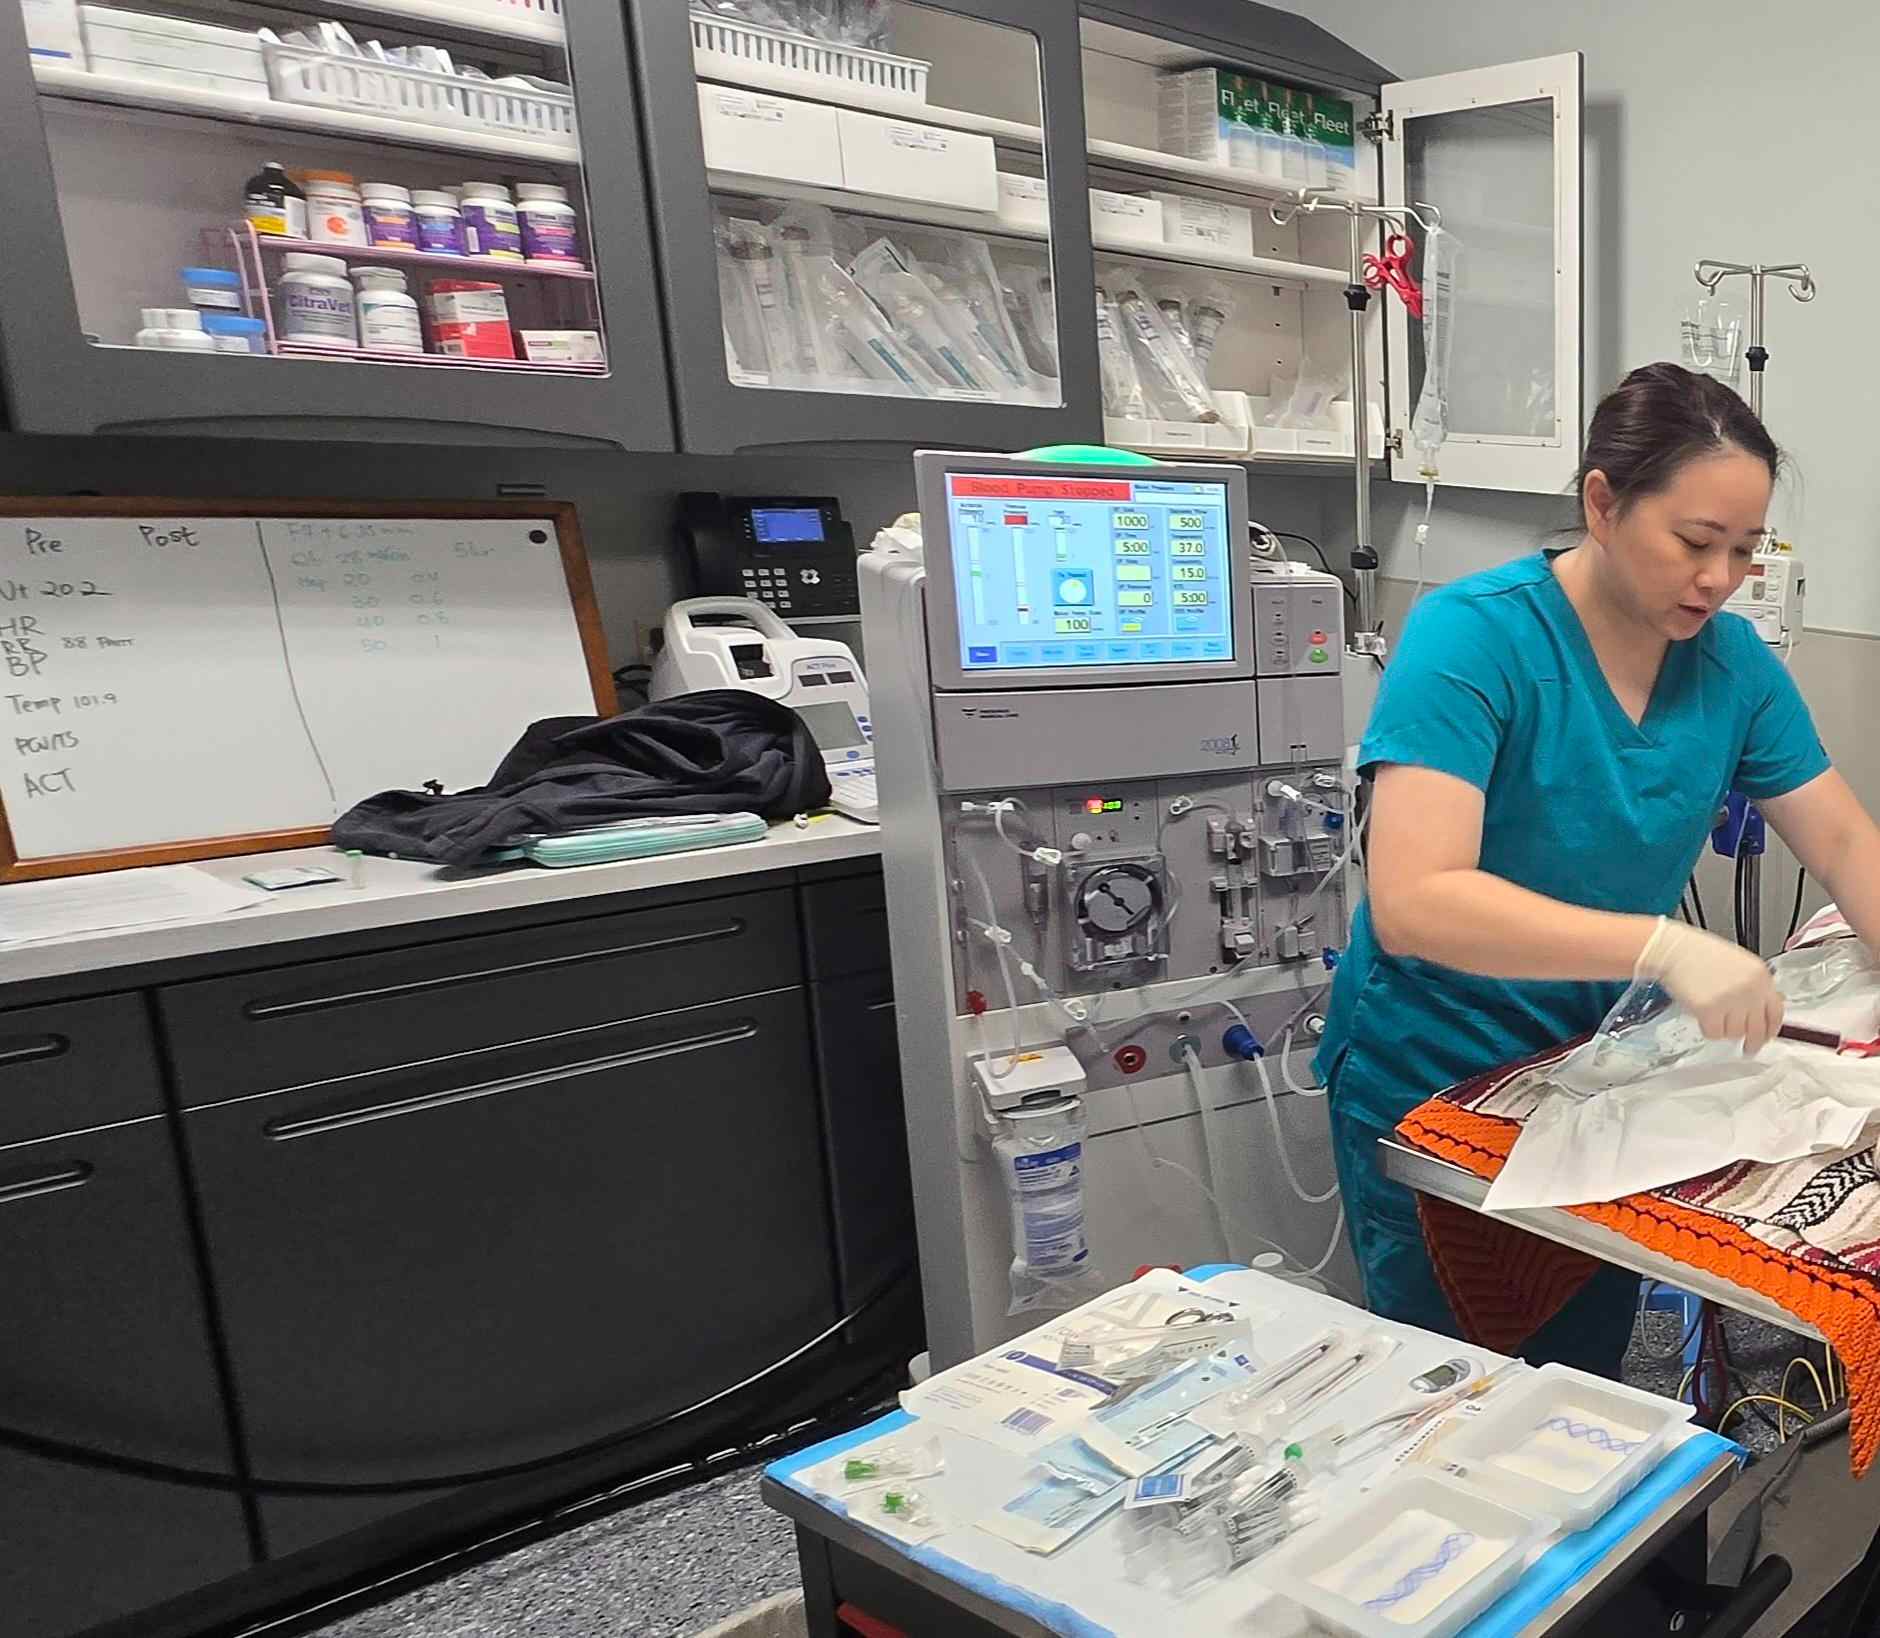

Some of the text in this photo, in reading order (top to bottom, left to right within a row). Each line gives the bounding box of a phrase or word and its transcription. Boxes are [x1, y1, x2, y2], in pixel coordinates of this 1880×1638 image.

[1221, 89, 1259, 114] Flet
[1314, 112, 1350, 135] Fleet
[971, 479, 1115, 498] Blood Pump Stopped
[1117, 516, 1147, 527] 1000
[1180, 517, 1201, 528] 500
[25, 525, 200, 554] Pre Post
[1123, 541, 1148, 553] 5:00
[1179, 542, 1203, 553] 37.0
[1180, 567, 1204, 578] 15.0
[1143, 593, 1152, 603] 0
[1181, 592, 1205, 603] 5:00
[0, 615, 45, 636] HR
[1066, 619, 1089, 630] 100
[7, 651, 48, 677] BP
[4, 692, 118, 715] Temp 101.9
[23, 767, 76, 799] ACT
